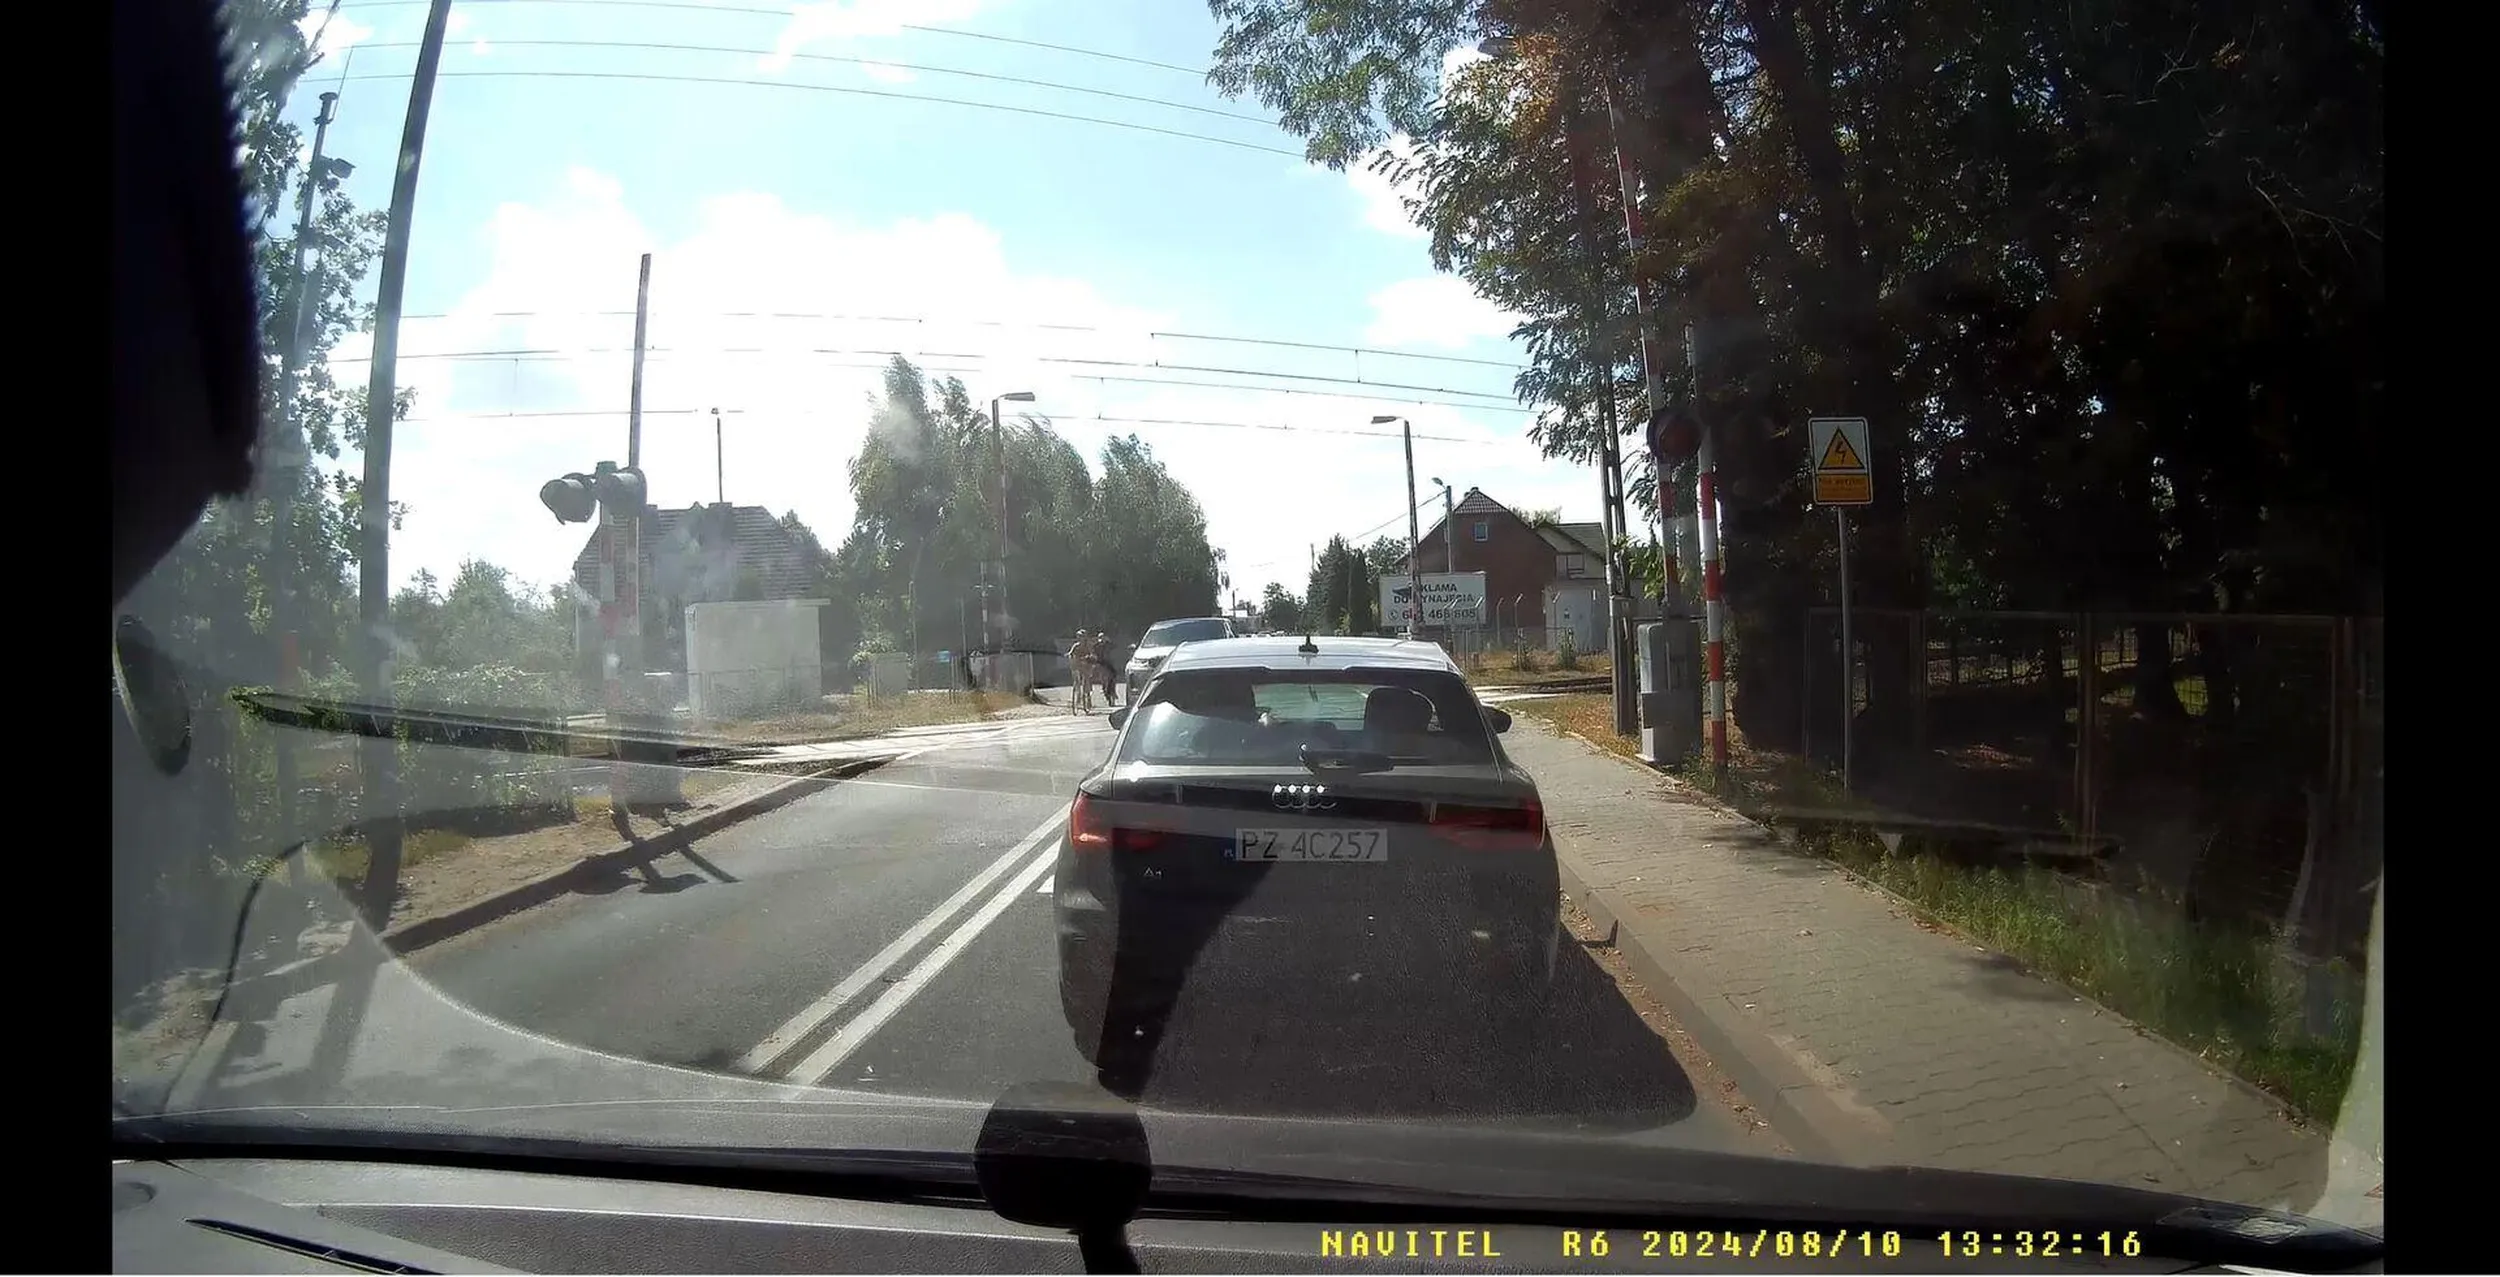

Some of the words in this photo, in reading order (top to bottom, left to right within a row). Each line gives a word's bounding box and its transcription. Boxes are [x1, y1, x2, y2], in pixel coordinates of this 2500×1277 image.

[1394, 596, 1409, 604] DO
[1241, 830, 1279, 860] PZ
[1291, 830, 1381, 860] 4C257
